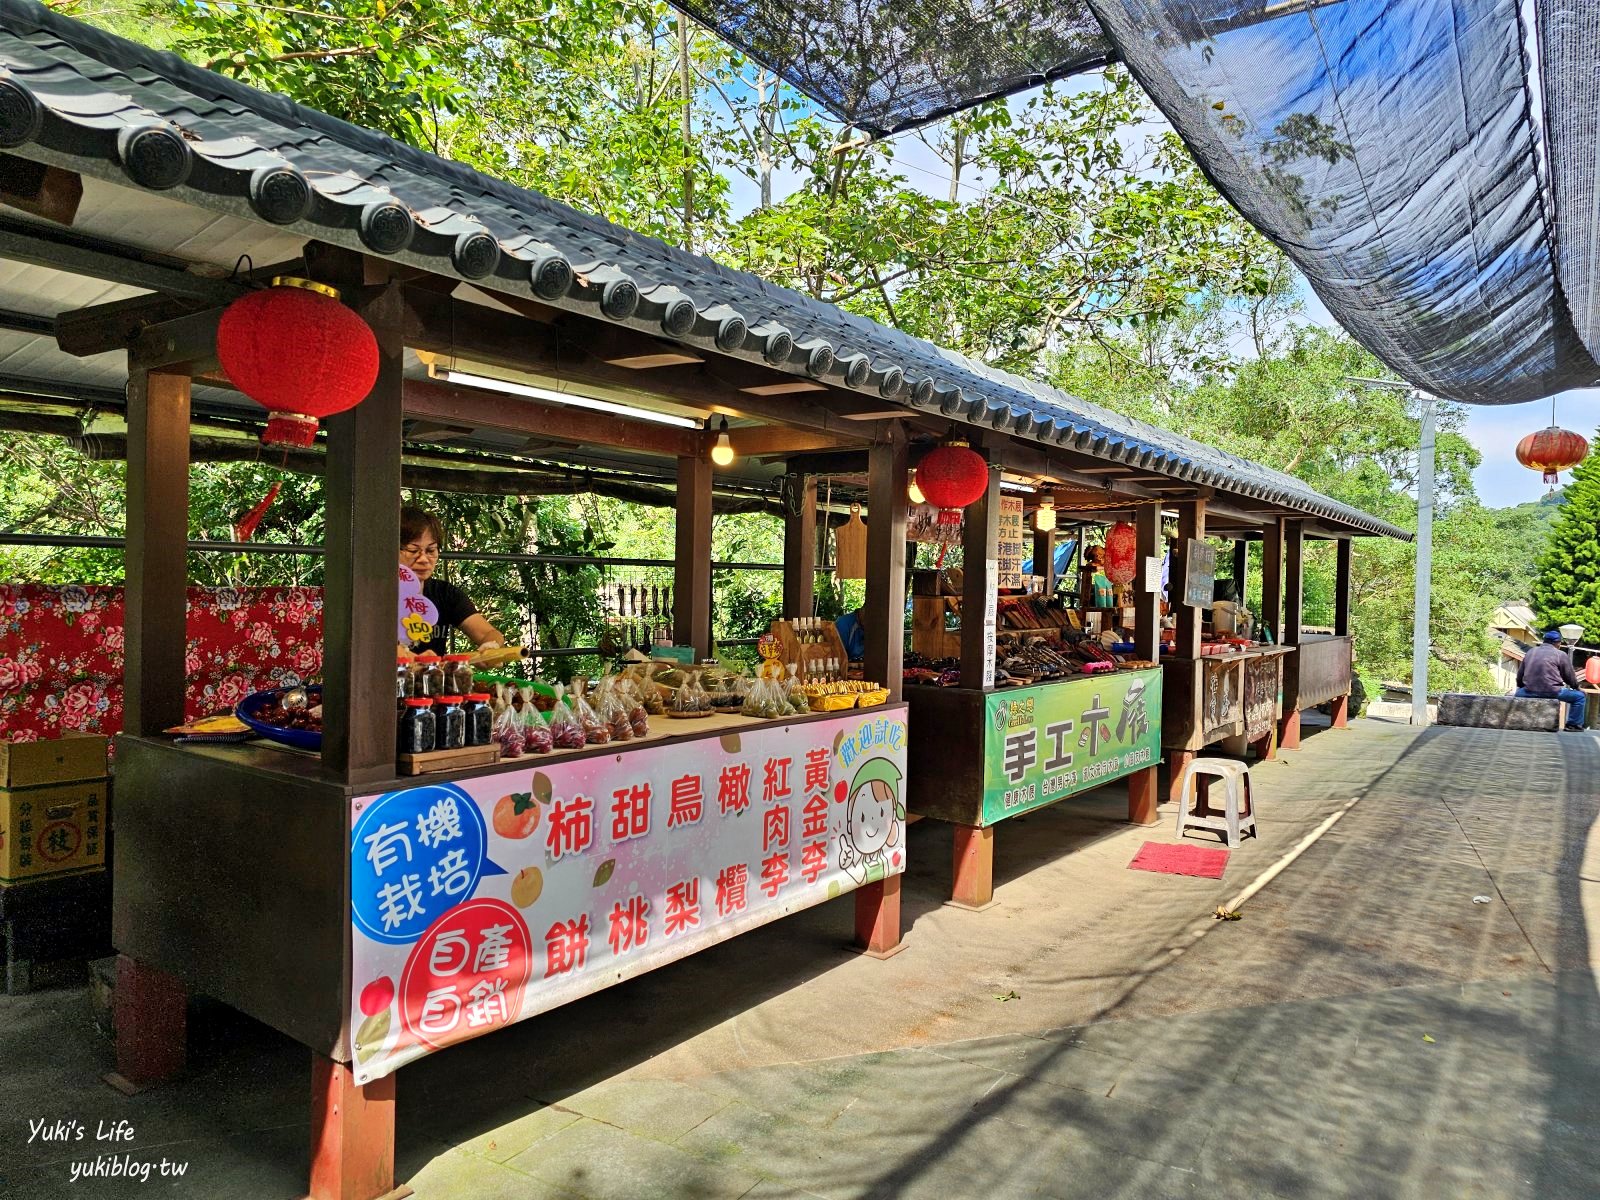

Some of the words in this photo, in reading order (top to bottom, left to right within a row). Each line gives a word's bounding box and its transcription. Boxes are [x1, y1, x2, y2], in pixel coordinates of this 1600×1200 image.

[409, 622, 429, 634] 150
[840, 719, 903, 769] 歡迎試吃
[1041, 770, 1078, 797] 台灣男子漢
[363, 796, 463, 877] 有機
[716, 762, 751, 914] 橄欖
[760, 758, 793, 898] 紅肉李
[801, 748, 831, 884] 黃金李
[376, 848, 471, 933] 栽培
[543, 797, 593, 980] 柿餅
[608, 782, 651, 957] 甜桃
[429, 923, 514, 977] 自產
[419, 977, 509, 1034] 自銷
